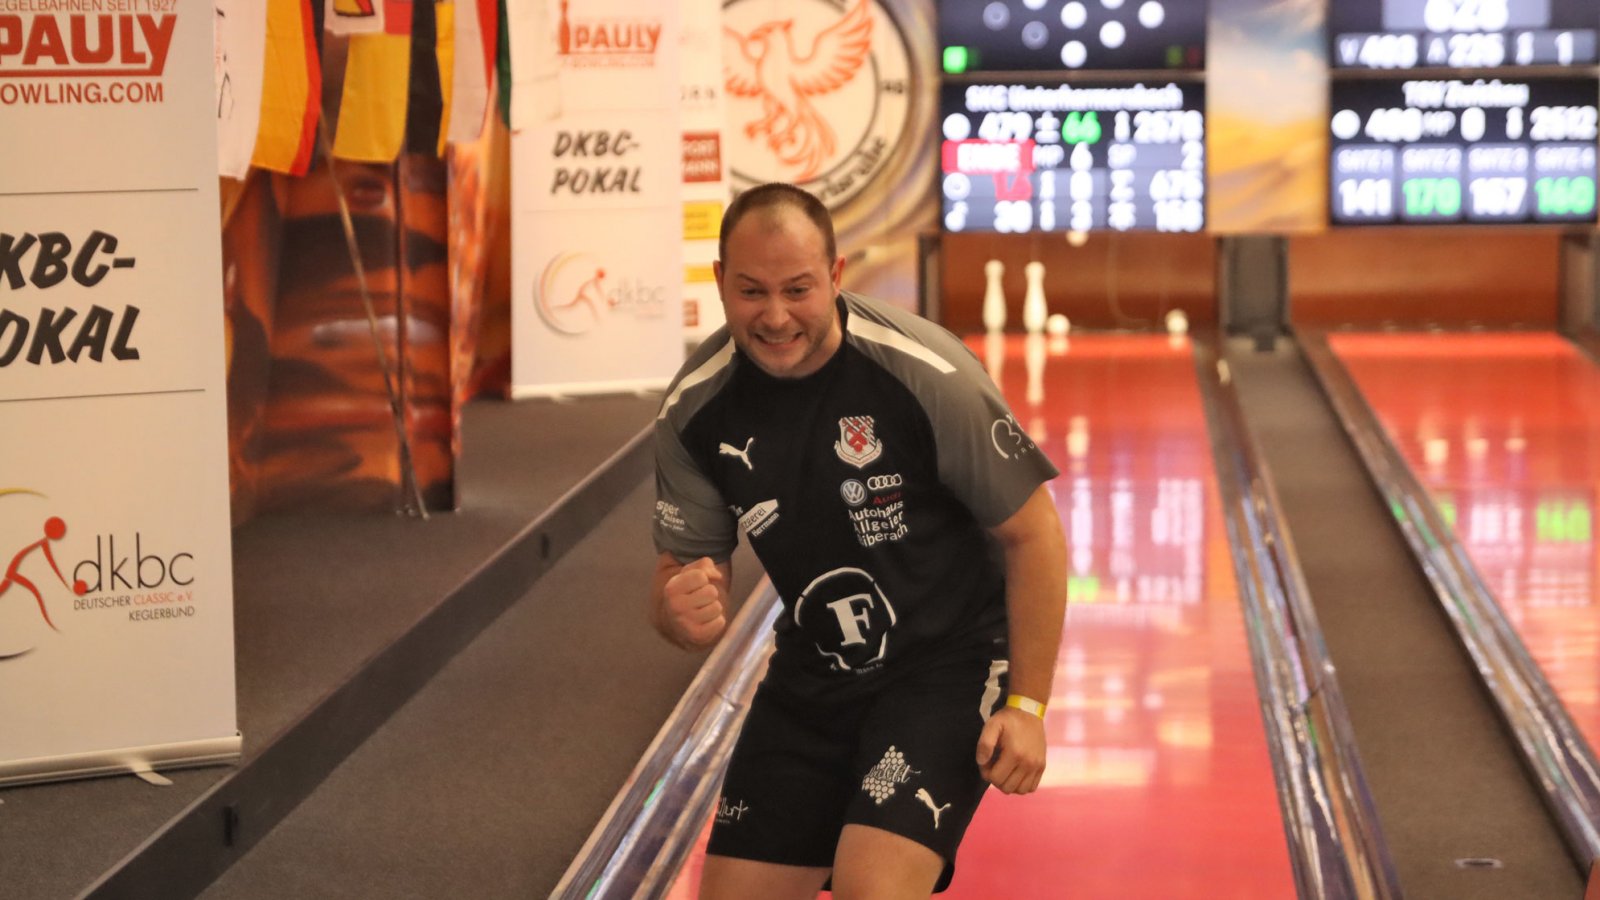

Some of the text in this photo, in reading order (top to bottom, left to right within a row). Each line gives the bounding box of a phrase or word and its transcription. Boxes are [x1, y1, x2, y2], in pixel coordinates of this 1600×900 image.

[107, 0, 139, 12] SEIT
[147, 0, 178, 12] 1927
[0, 14, 177, 76] PAULY
[574, 23, 662, 53] PAULY
[0, 82, 163, 105] OWLING.COM
[553, 131, 640, 158] DKBC-
[551, 167, 641, 194] POKAL
[848, 500, 904, 521] Autohaus
[73, 531, 195, 596] dkbc
[74, 595, 131, 611] DEUTSCHER
[133, 592, 174, 606] CLASSIC
[128, 606, 195, 622] KEGLERBUND
[826, 593, 874, 646] F
